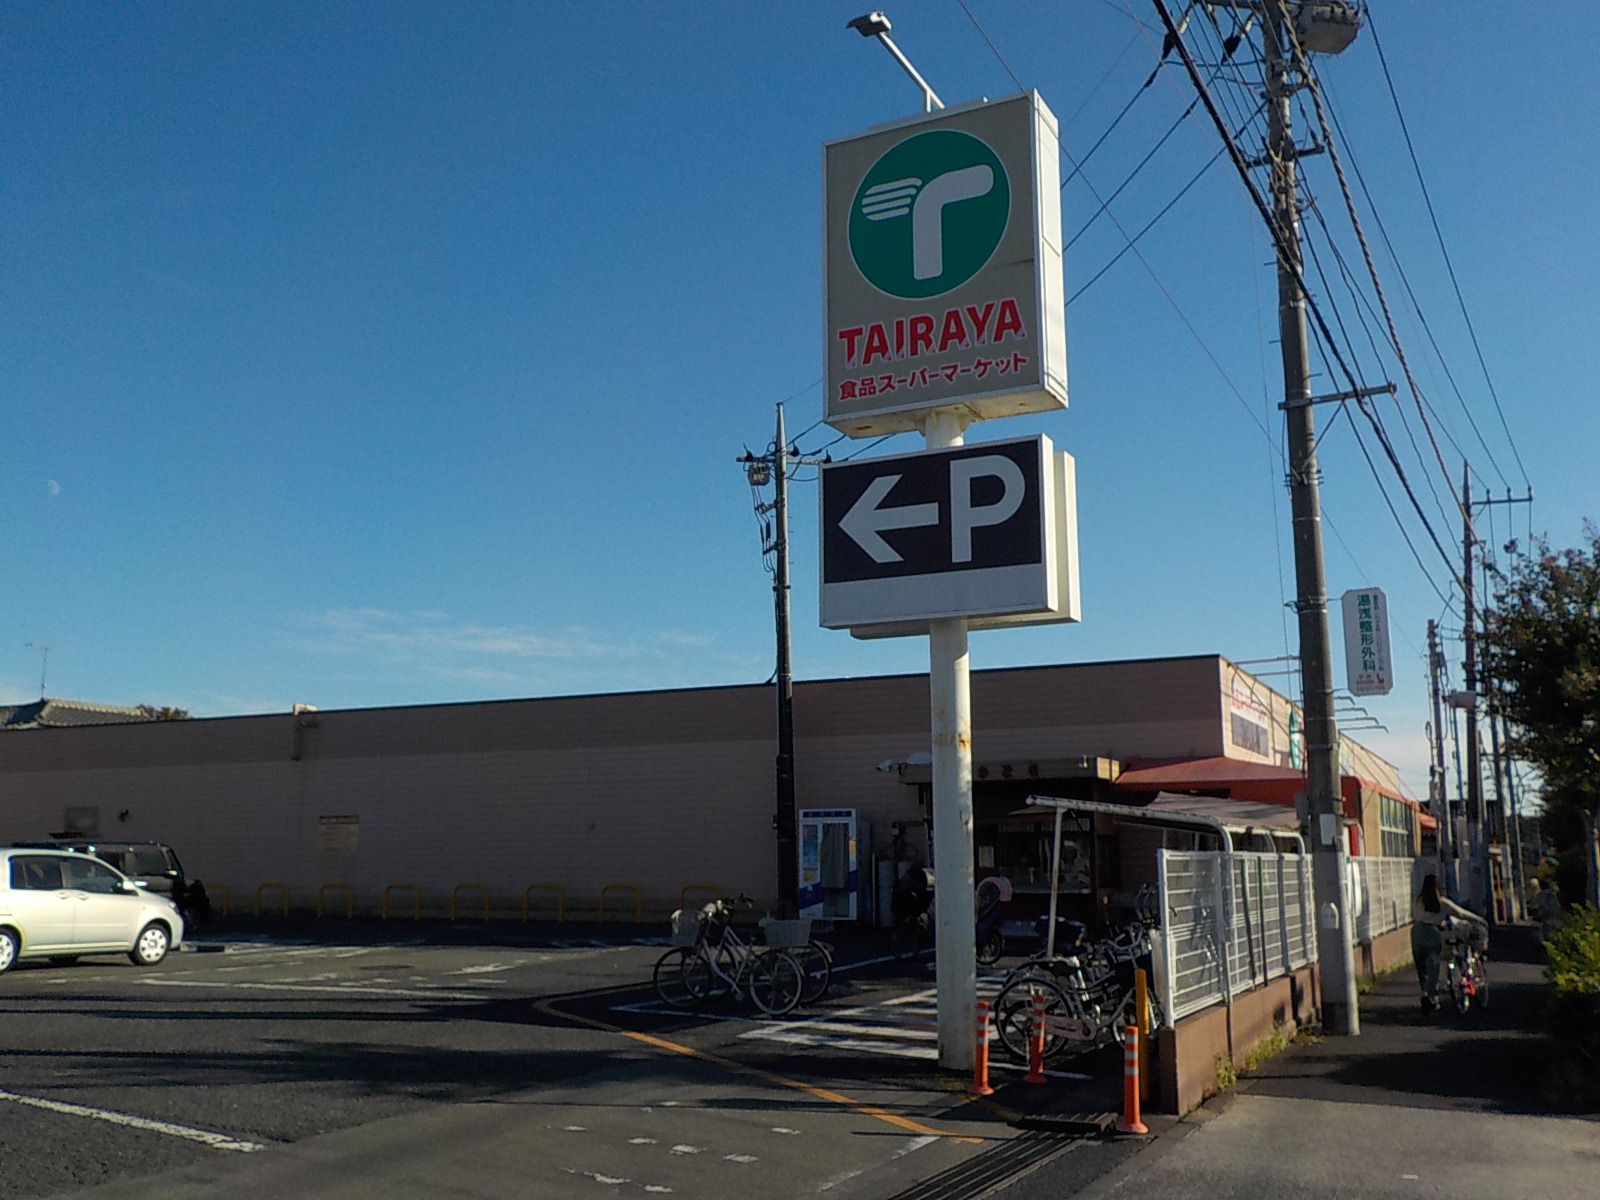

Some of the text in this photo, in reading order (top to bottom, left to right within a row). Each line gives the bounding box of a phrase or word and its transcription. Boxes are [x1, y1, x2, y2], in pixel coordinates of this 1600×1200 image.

[838, 298, 1026, 369] TAIRAYA
[838, 352, 1028, 400] 食品スーパーマーケット
[950, 454, 1026, 564] P
